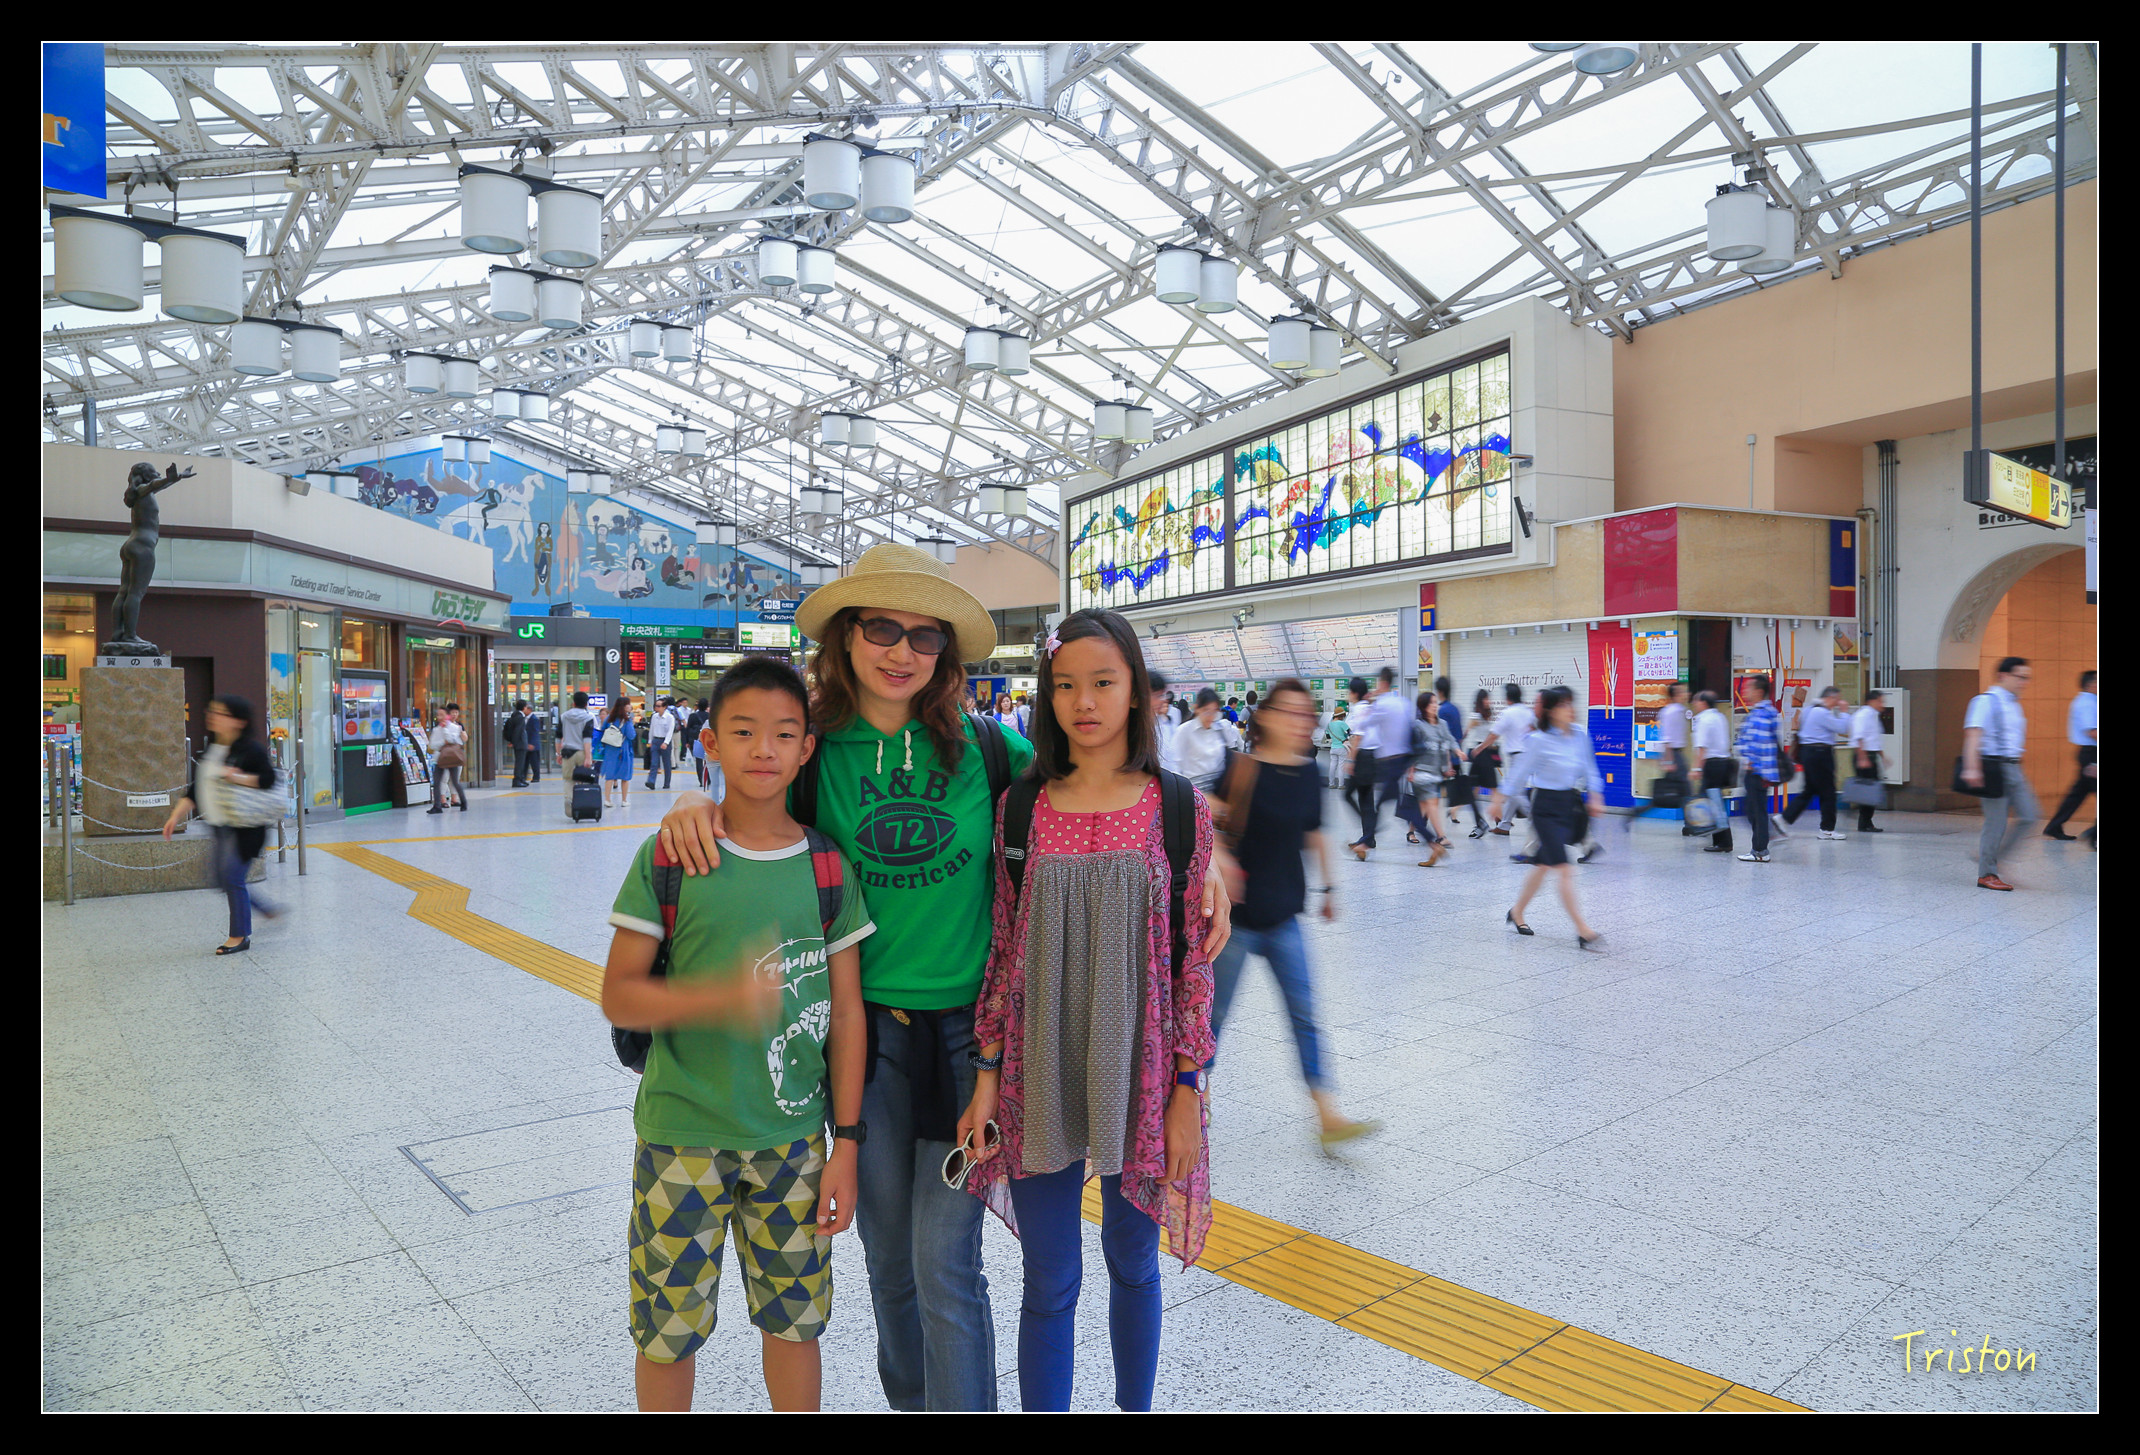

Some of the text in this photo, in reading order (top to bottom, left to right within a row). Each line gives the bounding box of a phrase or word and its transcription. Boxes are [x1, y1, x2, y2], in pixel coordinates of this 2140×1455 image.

[290, 575, 381, 602] Ticketing and Travel Service Center
[432, 590, 486, 622] びゅうプラザ
[519, 623, 544, 638] JR
[627, 626, 662, 636] 中央改札
[107, 658, 162, 666] 翼の像
[1479, 669, 1564, 692] Sugar Butter Tree
[885, 818, 928, 849] 72
[853, 847, 973, 889] American
